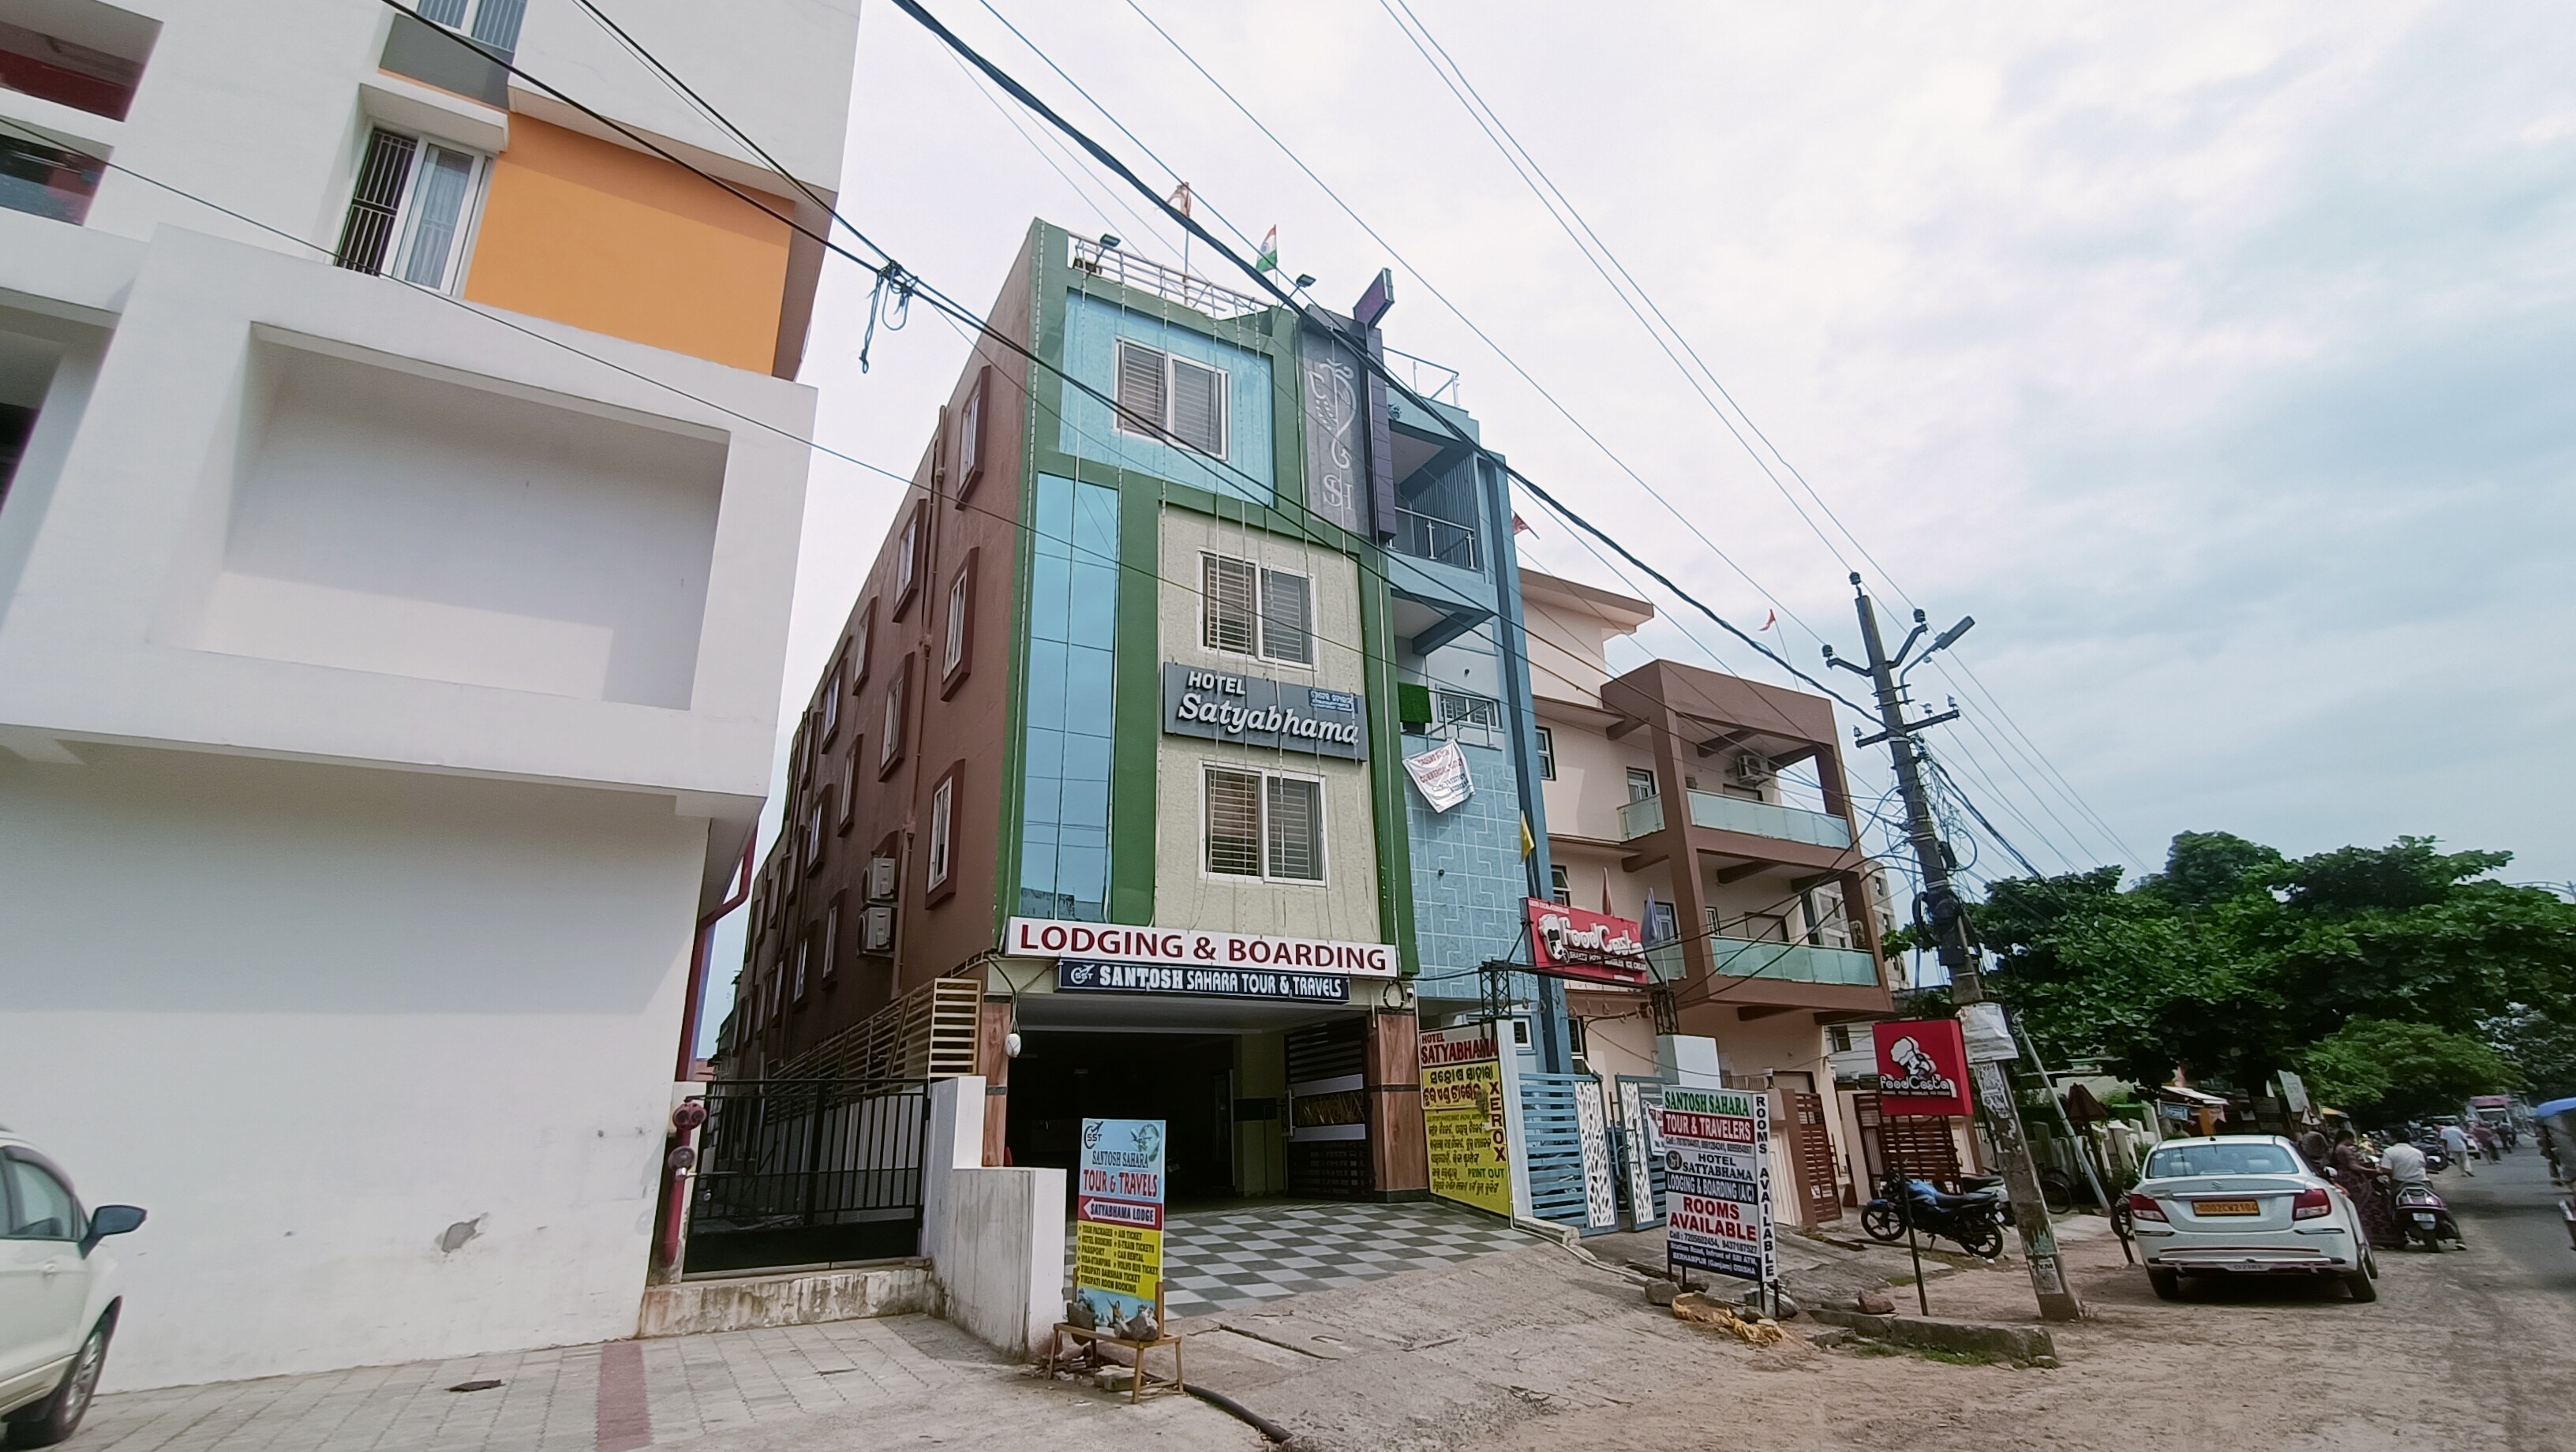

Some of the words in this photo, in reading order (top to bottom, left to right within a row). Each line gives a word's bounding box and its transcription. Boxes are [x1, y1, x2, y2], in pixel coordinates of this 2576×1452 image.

[1188, 671, 1245, 695] HOTEL
[1178, 693, 1359, 743] Satyabhama
[1020, 924, 1183, 957] LODGING
[1193, 937, 1216, 961] &
[1229, 938, 1387, 971] BOARDING
[1099, 965, 1183, 990] SANTOSH
[1187, 970, 1238, 992] SAHARA
[1241, 973, 1275, 994] TOUR
[1279, 975, 1290, 994] &
[1293, 976, 1342, 997] TRAVELS
[1422, 1032, 1445, 1044] HOTEL
[1664, 1091, 1707, 1113] SANTOSH
[1709, 1095, 1750, 1117] SAHARA
[1488, 1081, 1506, 1162] XEROX
[1665, 1113, 1689, 1134] TOUR
[1691, 1117, 1697, 1135] &
[1699, 1117, 1751, 1140] TRAVELERS
[1756, 1096, 1768, 1154] ROOMS
[1092, 1151, 1121, 1166] SANTOSH
[1122, 1152, 1148, 1168] SAHARA
[1683, 1162, 1753, 1181] SATYABHAMA
[1698, 1153, 1736, 1166] HOTEL
[1084, 1169, 1107, 1192] TOUR
[1110, 1175, 1116, 1193] &
[1119, 1172, 1158, 1197] TRAVELS
[1488, 1168, 1504, 1178] OUT
[1667, 1173, 1695, 1192] LODGING
[1696, 1177, 1702, 1194] &
[1703, 1178, 1737, 1199] BOARDING
[1090, 1203, 1130, 1219] SATYABHAMA
[1133, 1207, 1153, 1222] LODGE
[1683, 1196, 1739, 1220] ROOMS
[1669, 1212, 1757, 1241] AVAILABLE
[1759, 1168, 1774, 1277] AVAILABLE
[1126, 1230, 1142, 1241] TICKET
[1124, 1272, 1140, 1283] TICKET
[1142, 1264, 1159, 1275] TICKET
